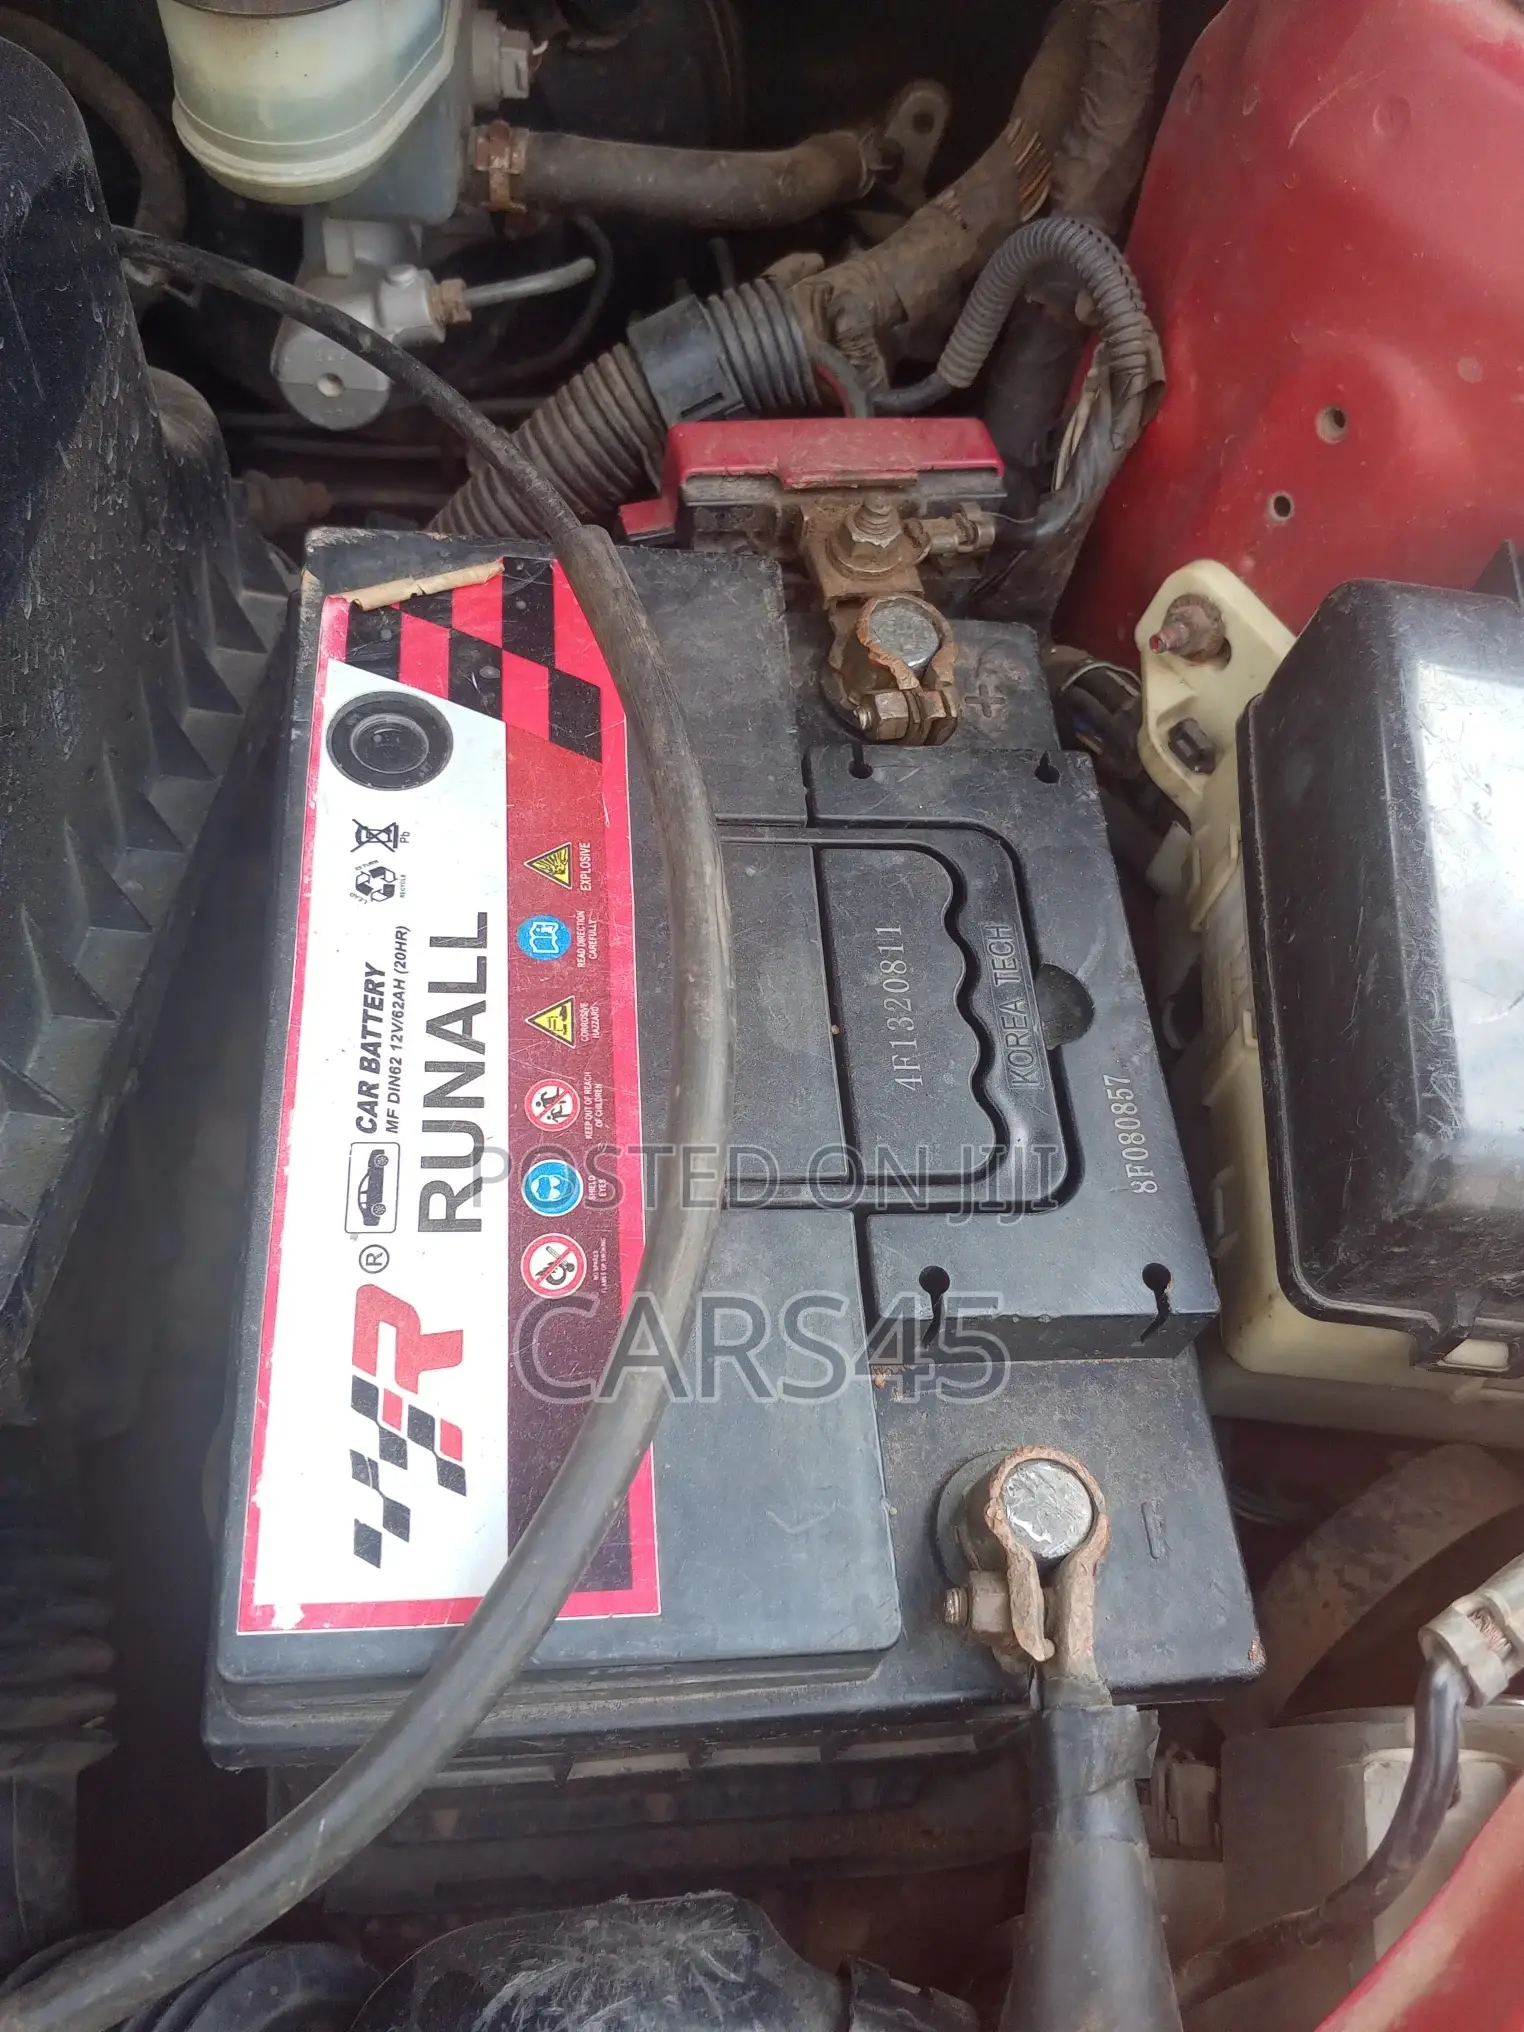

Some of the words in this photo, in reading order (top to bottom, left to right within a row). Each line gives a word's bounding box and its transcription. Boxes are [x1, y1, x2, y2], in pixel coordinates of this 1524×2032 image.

[400, 831, 410, 843] Pb
[579, 842, 592, 891] EXPLOSIVE
[575, 910, 586, 948] DIRECTION
[588, 919, 598, 960] CAREFULLY
[393, 925, 411, 975] (20HR)
[576, 948, 586, 968] READ
[985, 923, 1021, 987] TECH
[359, 961, 386, 1075] BATTERY
[390, 979, 407, 1051] 12V/62AH
[579, 1002, 590, 1042] CORROSIVE
[590, 1006, 600, 1039] HAZZARD
[874, 923, 924, 1092] 4F1320811
[998, 999, 1036, 1085] KOREA
[387, 1057, 402, 1104] DIN62
[417, 911, 488, 1232] RUNALL
[583, 1072, 592, 1091] REACH
[355, 1080, 381, 1134] CAR
[584, 1107, 593, 1121] OUT
[594, 1083, 603, 1117] CHILDREN
[386, 1109, 401, 1134] MF
[584, 1121, 593, 1139] KEEP
[595, 1118, 603, 1128] OF
[1102, 1073, 1158, 1195] 8F080857
[588, 1174, 598, 1200] SHIELD
[598, 1178, 607, 1198] EYES
